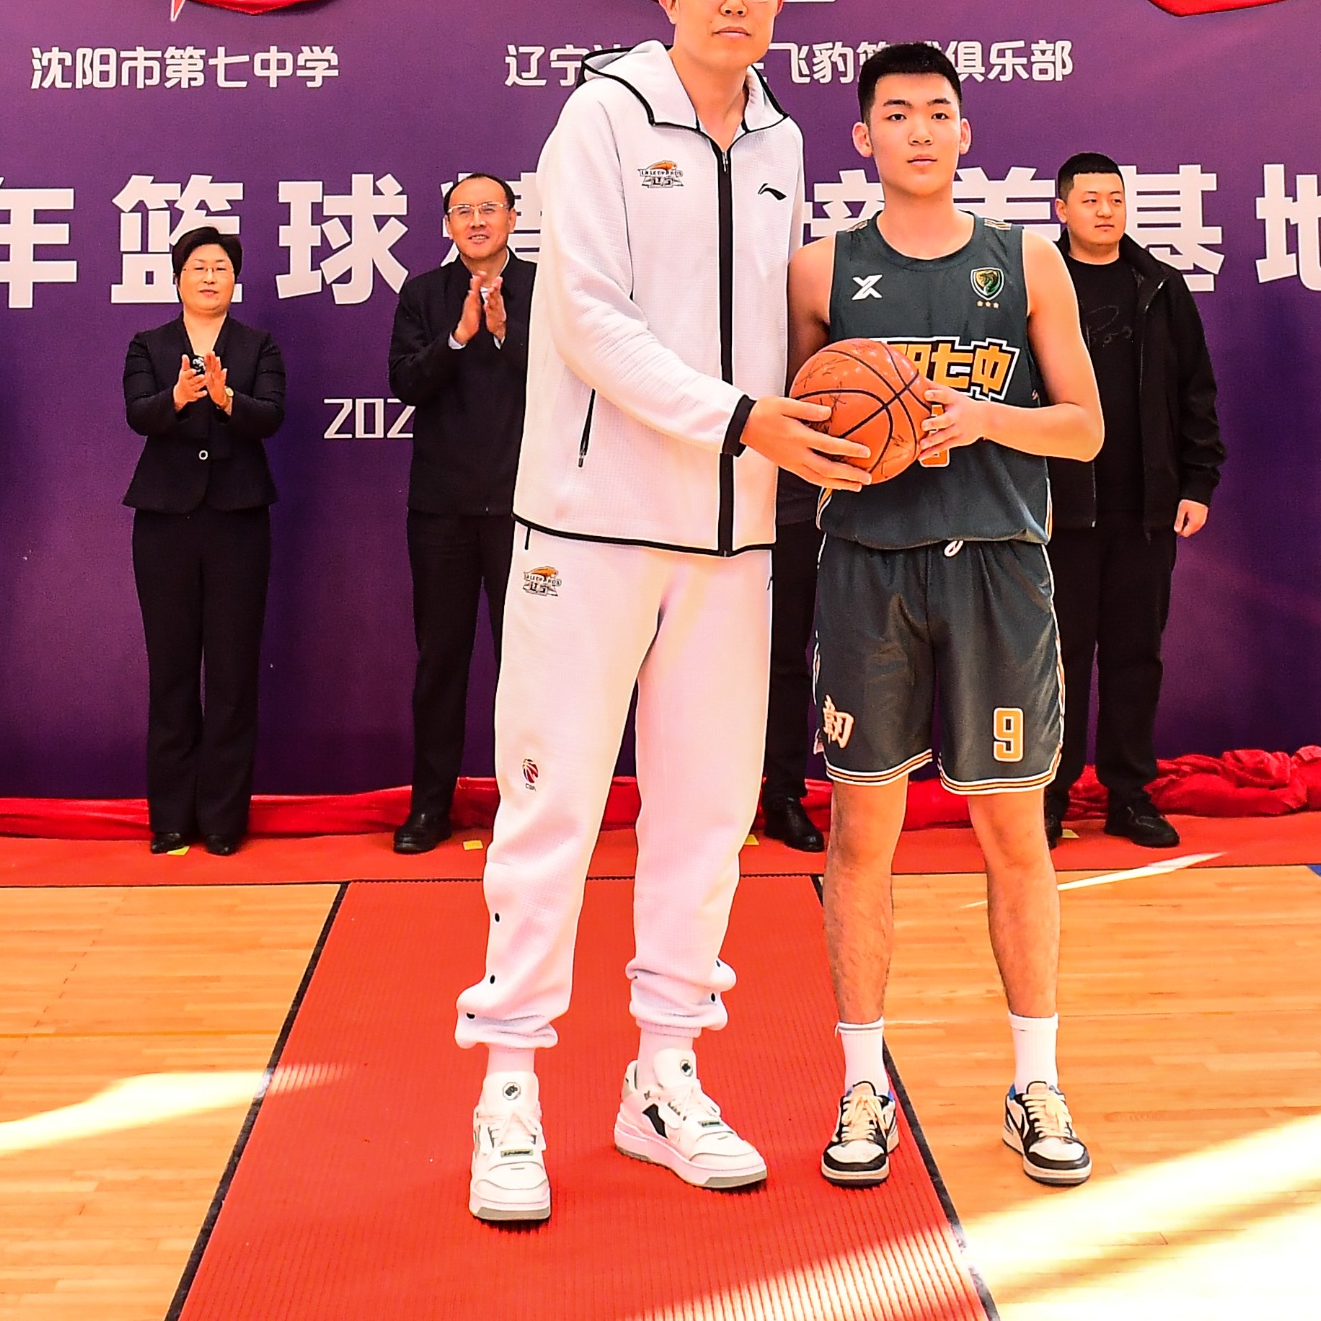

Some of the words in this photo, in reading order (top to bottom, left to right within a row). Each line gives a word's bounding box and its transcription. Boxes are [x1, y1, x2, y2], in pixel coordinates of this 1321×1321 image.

[31, 45, 339, 89] 沈阳市第七中学
[993, 707, 1024, 762] 9
